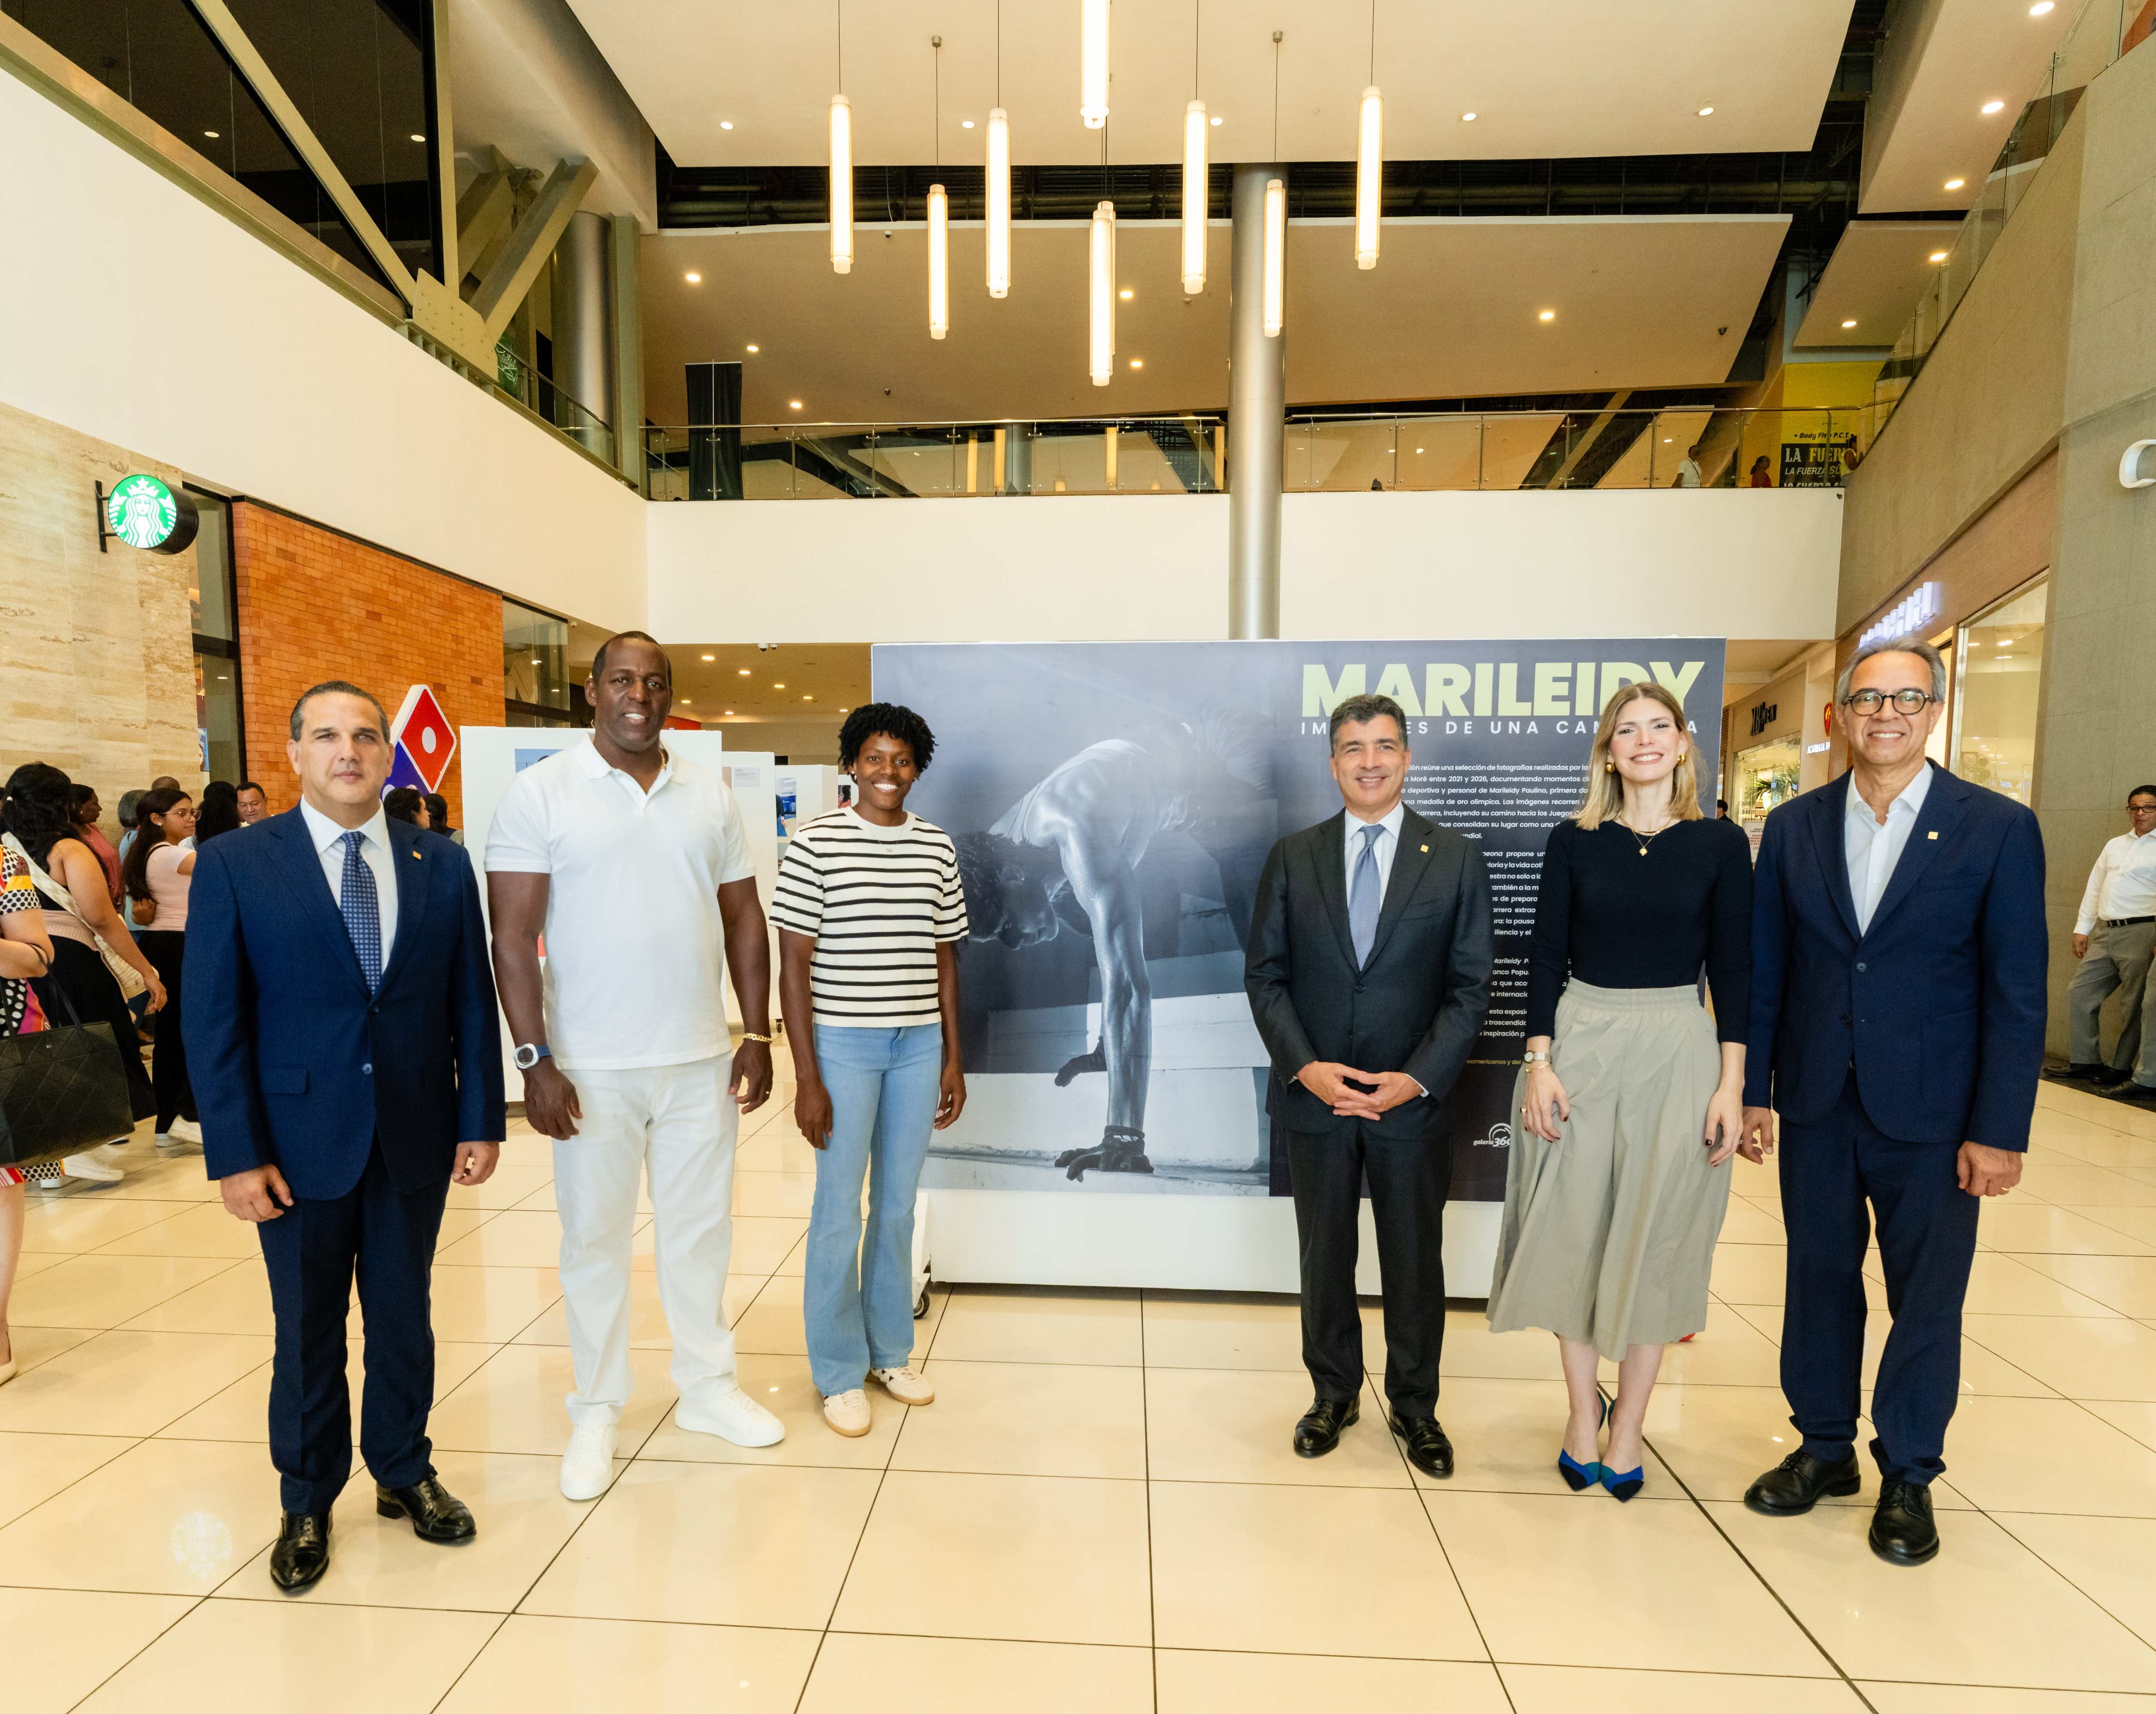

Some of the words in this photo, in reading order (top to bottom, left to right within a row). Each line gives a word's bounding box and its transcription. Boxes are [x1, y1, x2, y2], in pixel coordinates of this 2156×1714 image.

[1785, 448, 1802, 462] LA
[1809, 448, 1845, 462] FUER
[1302, 661, 1705, 717] MARILEIDY
[1445, 721, 1473, 734] DE
[1490, 721, 1539, 734] UNA
[1496, 764, 1533, 772] fotografías
[1516, 798, 1549, 806] imágenes
